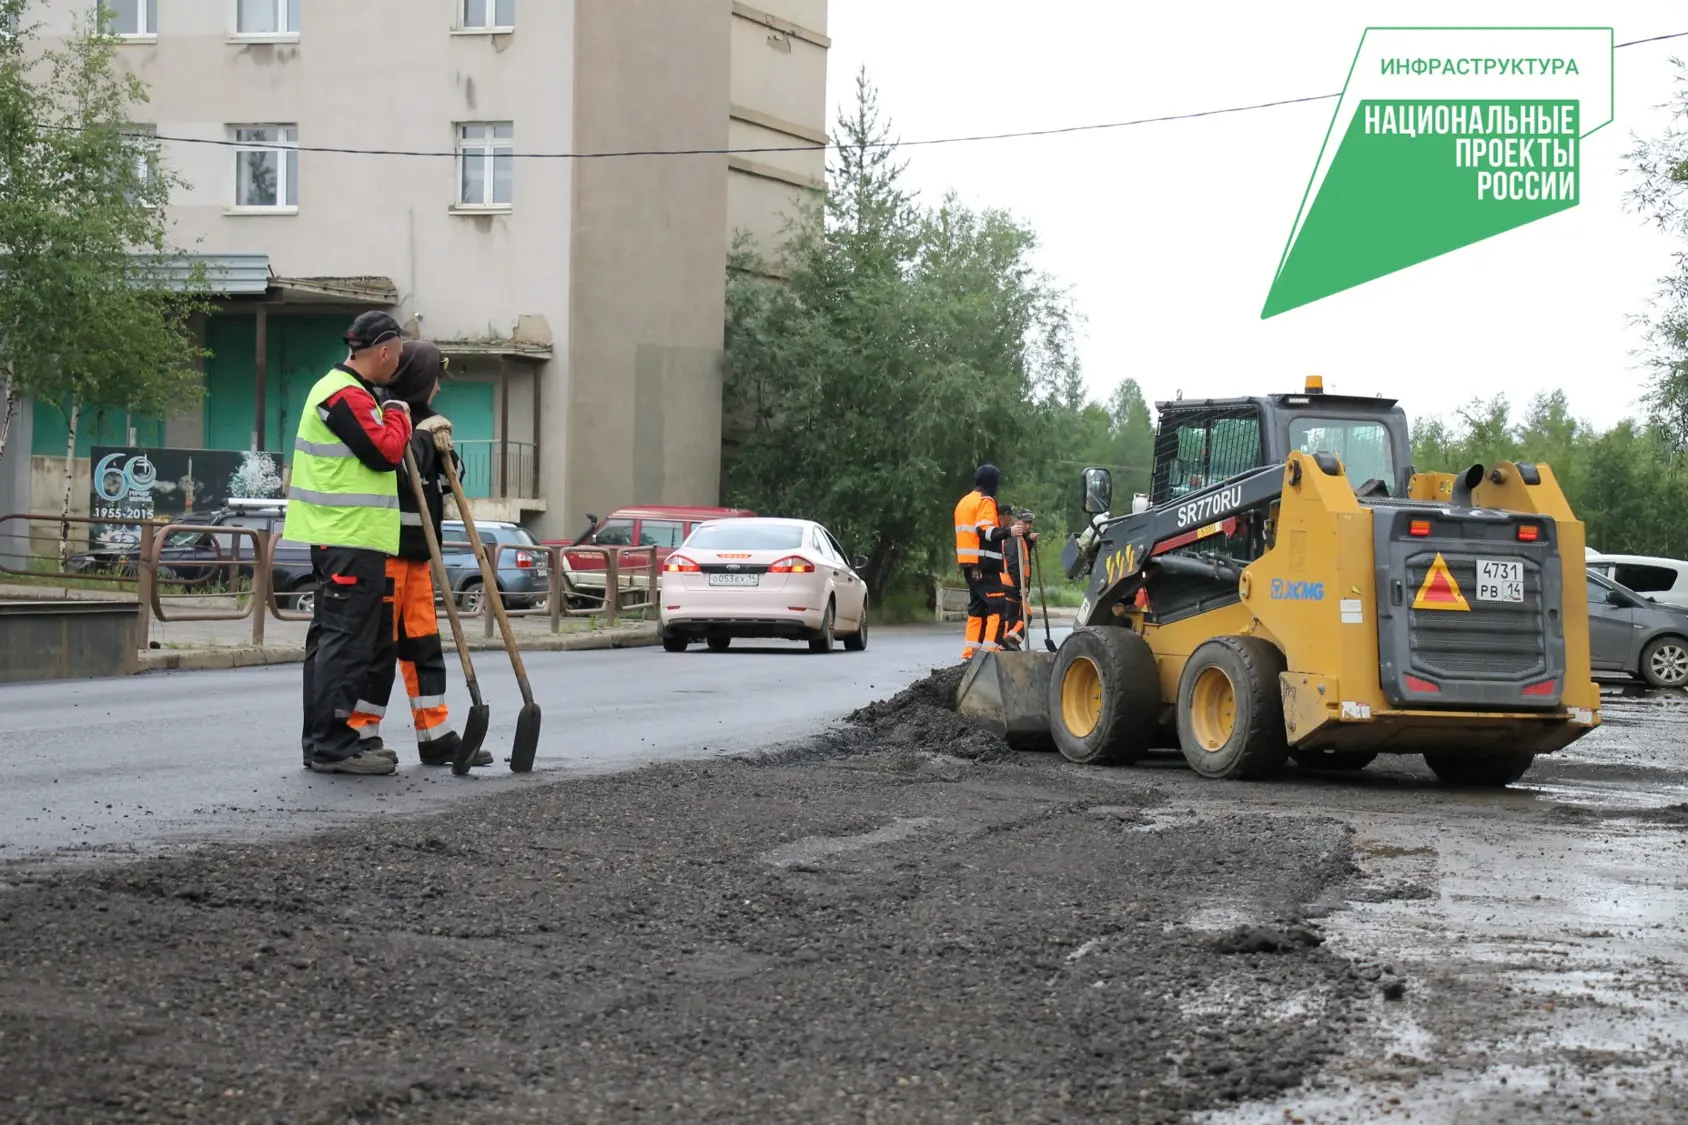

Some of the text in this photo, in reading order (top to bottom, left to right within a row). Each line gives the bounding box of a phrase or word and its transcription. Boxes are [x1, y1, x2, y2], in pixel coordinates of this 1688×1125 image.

[95, 508, 154, 519] 1955-2015
[1177, 486, 1241, 527] SR770RU
[1483, 562, 1518, 580] 4731
[1286, 581, 1325, 601] XCMG
[1507, 583, 1521, 596] 14
